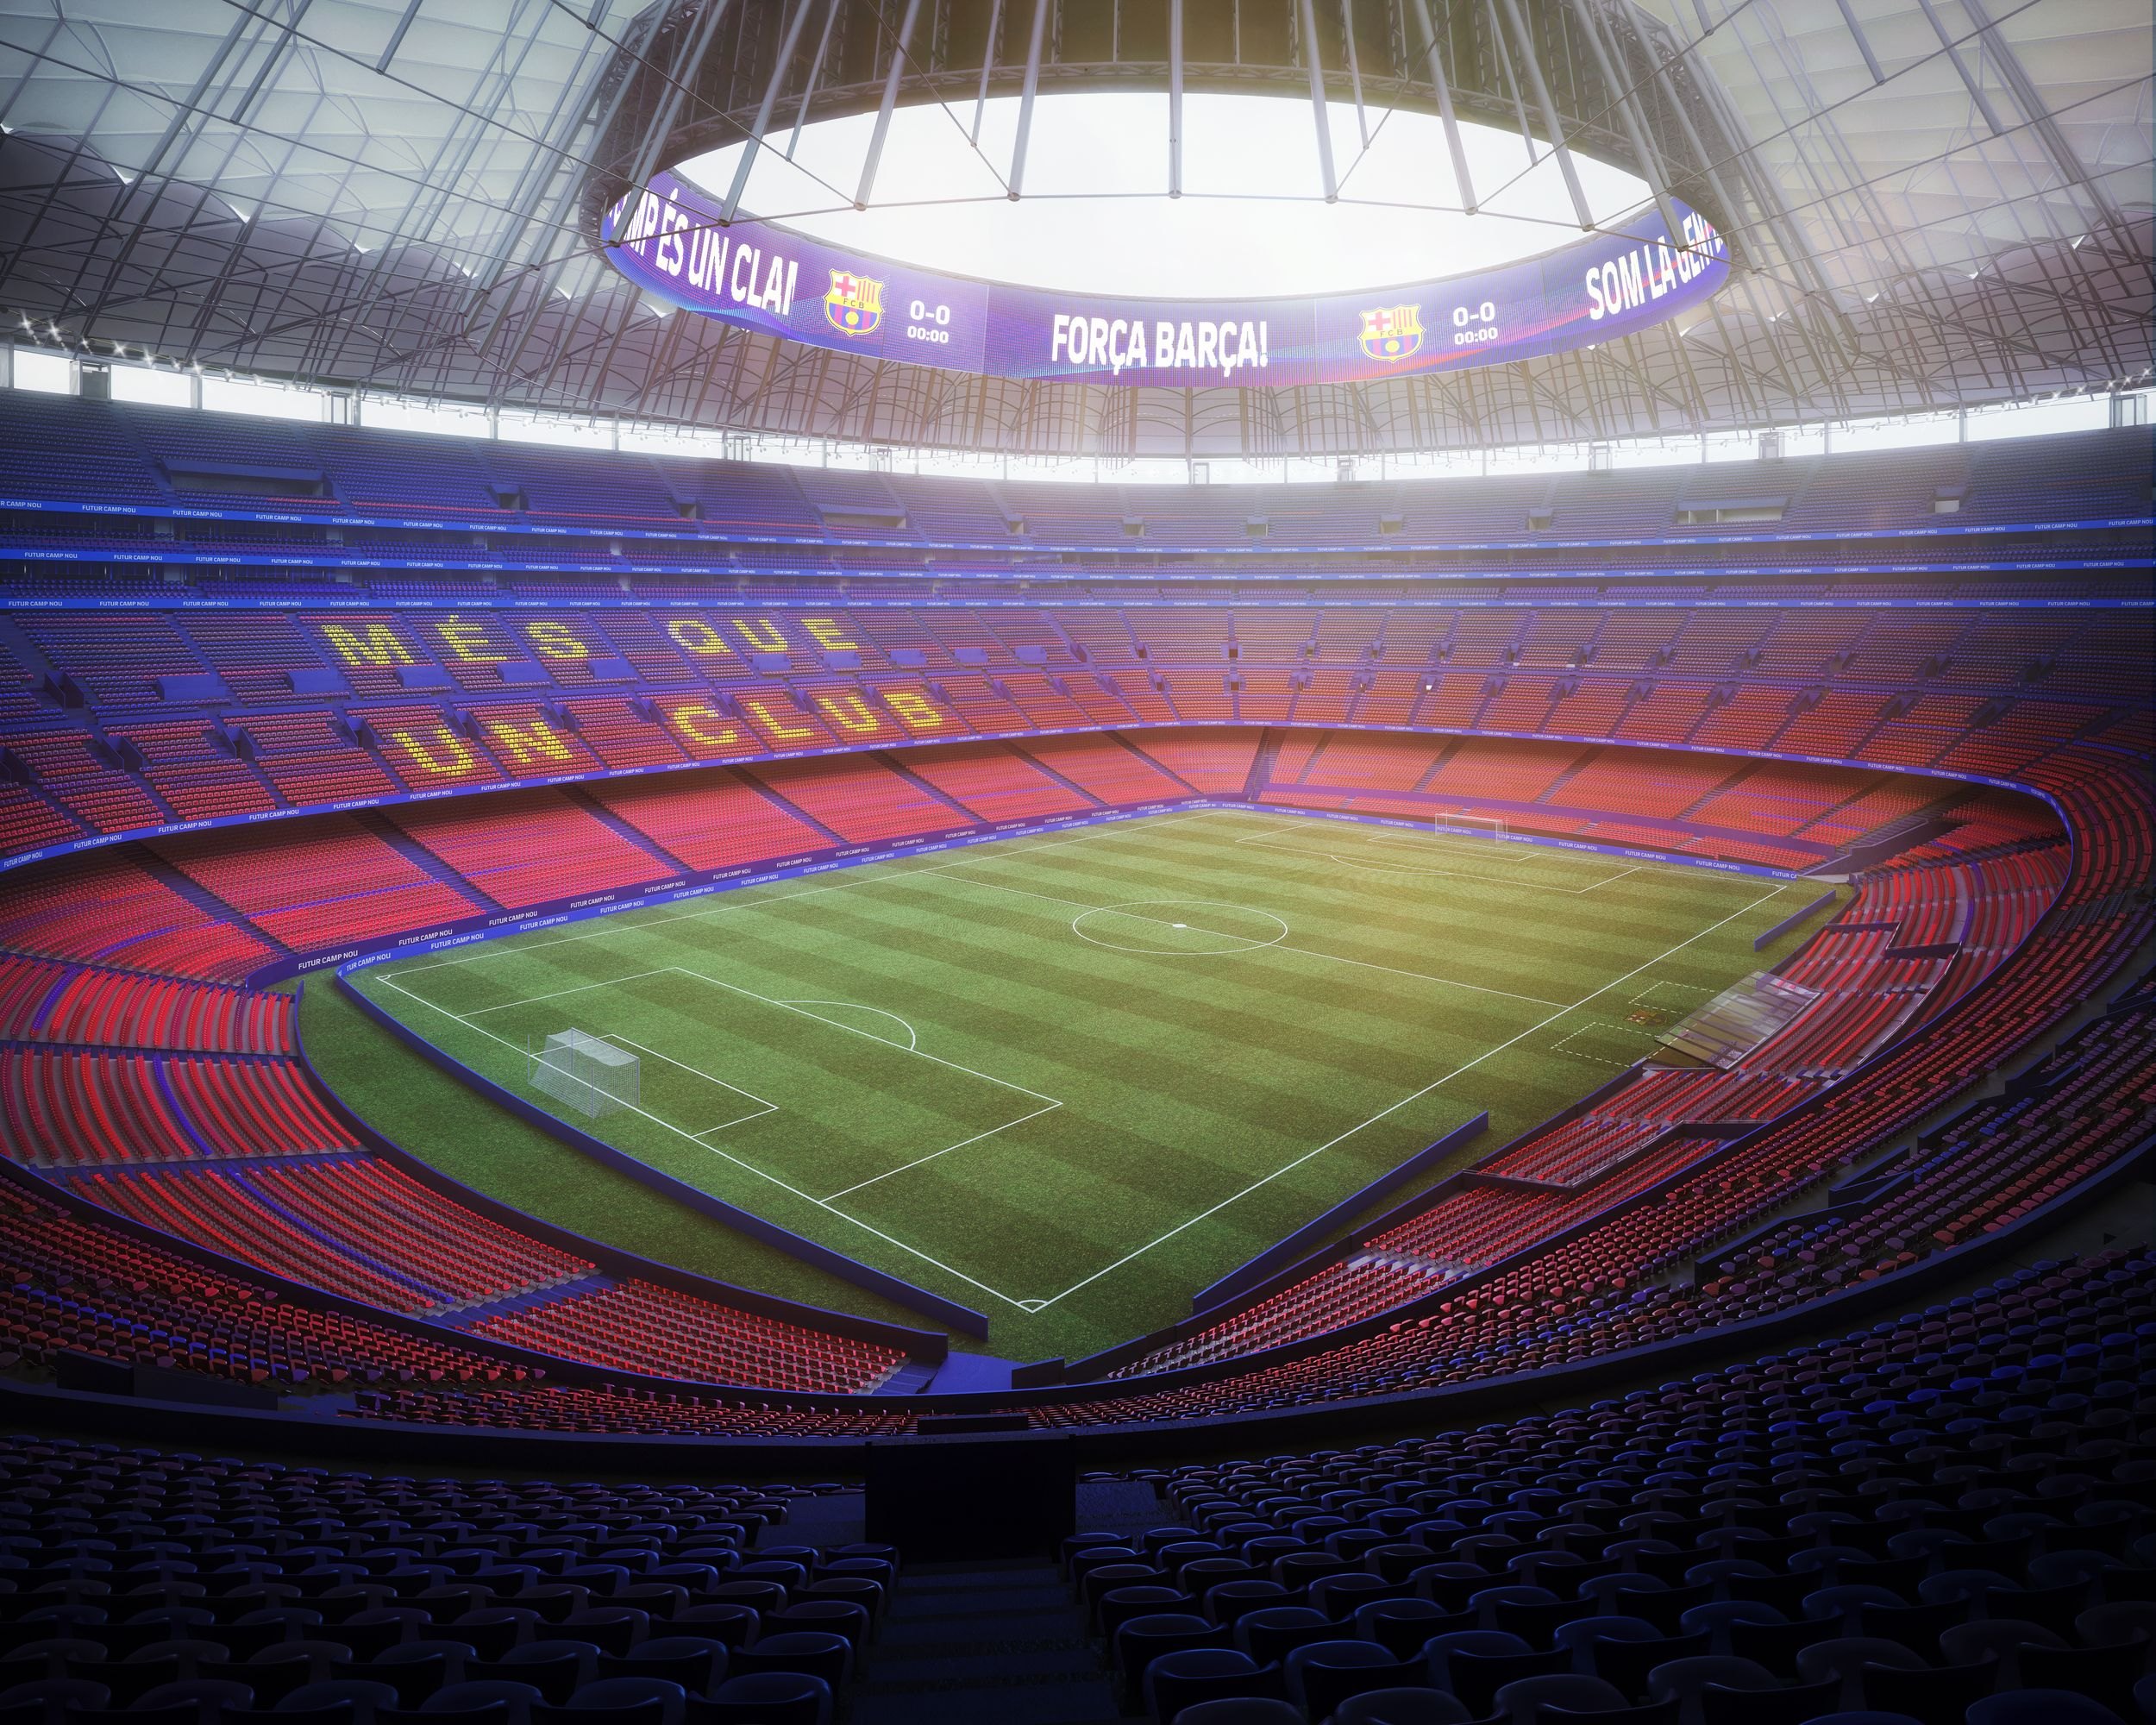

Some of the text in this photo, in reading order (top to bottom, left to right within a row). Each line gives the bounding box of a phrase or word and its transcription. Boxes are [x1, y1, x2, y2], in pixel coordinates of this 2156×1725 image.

[655, 188, 689, 276] ÉS
[689, 223, 729, 295] UN
[1586, 250, 1645, 320] SOM
[1644, 235, 1677, 299] LA
[843, 298, 864, 309] FCB
[910, 300, 950, 325] 0-0
[1453, 301, 1495, 327] 0-0
[907, 326, 949, 344] 00:00
[1454, 327, 1498, 345] 00:00
[1052, 314, 1269, 377] FORÇA BARÇA!
[321, 614, 859, 666] MÉS QUE
[392, 693, 943, 777] UN CLUB
[158, 825, 179, 833] FUTUR
[179, 822, 198, 830] CAMP
[74, 840, 92, 849] FUTUR
[92, 836, 109, 845] CAMP
[4, 851, 43, 867] FUTUR CAMP NOU
[644, 885, 661, 893] FUTUR
[661, 882, 675, 890] CAMP
[673, 891, 690, 899] FUTUR
[689, 888, 704, 896] CAMP
[570, 900, 588, 909] FUTUR
[588, 897, 604, 905] CAMP
[600, 905, 617, 914] FUTUR
[617, 902, 633, 910] CAMP
[489, 910, 538, 926] FUTUR CAMP NOU
[520, 921, 539, 930] FUTUR
[539, 918, 556, 926] CAMP
[398, 929, 453, 946] FUTUR CAMP NOU
[431, 933, 484, 949] FUTUR CAMP NOU
[298, 950, 358, 970] FUTUR CAMP NOU
[357, 956, 376, 967] CAMP
[376, 952, 391, 961] NOU
